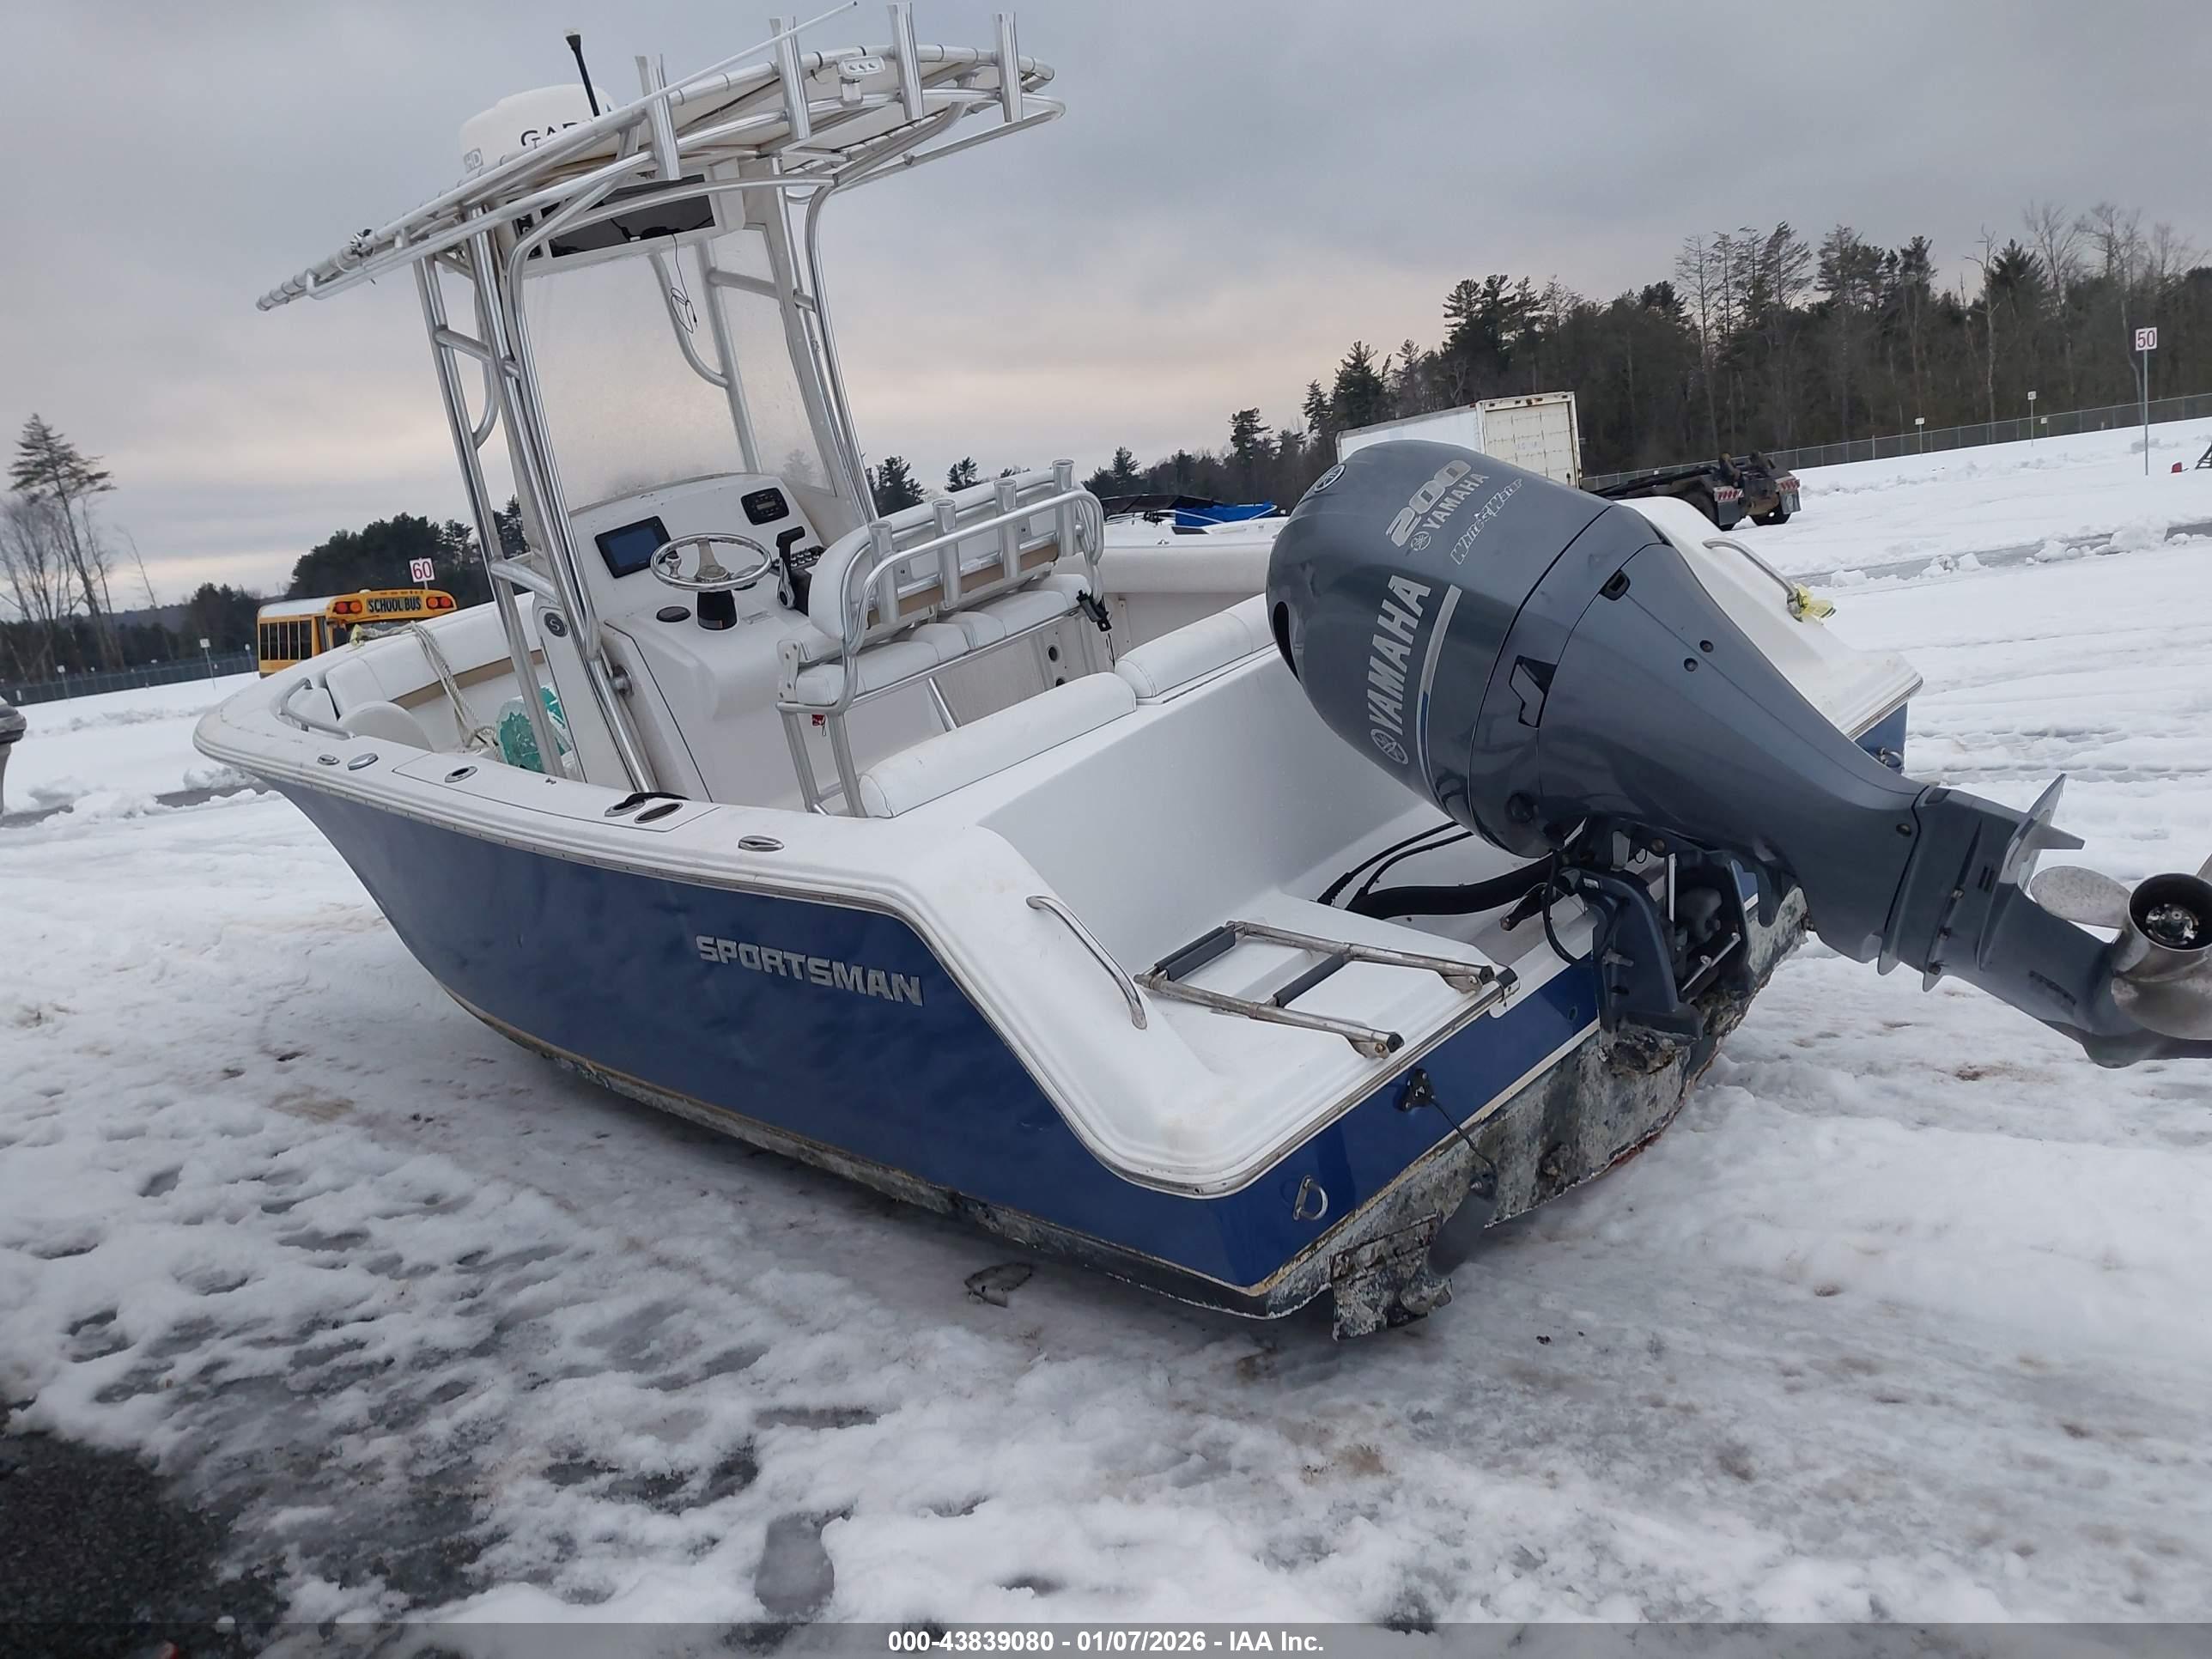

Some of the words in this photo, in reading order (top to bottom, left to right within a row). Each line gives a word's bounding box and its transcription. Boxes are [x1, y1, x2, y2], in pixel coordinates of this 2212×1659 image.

[2137, 330, 2155, 349] 50
[1386, 460, 1472, 547] 200
[1422, 473, 1490, 529] YAMAHA
[412, 561, 432, 580] 60
[368, 598, 404, 613] SCHOOL
[404, 596, 422, 611] BUS
[1367, 574, 1431, 736] YAMAHA
[696, 934, 924, 1007] SPORTSMAN
